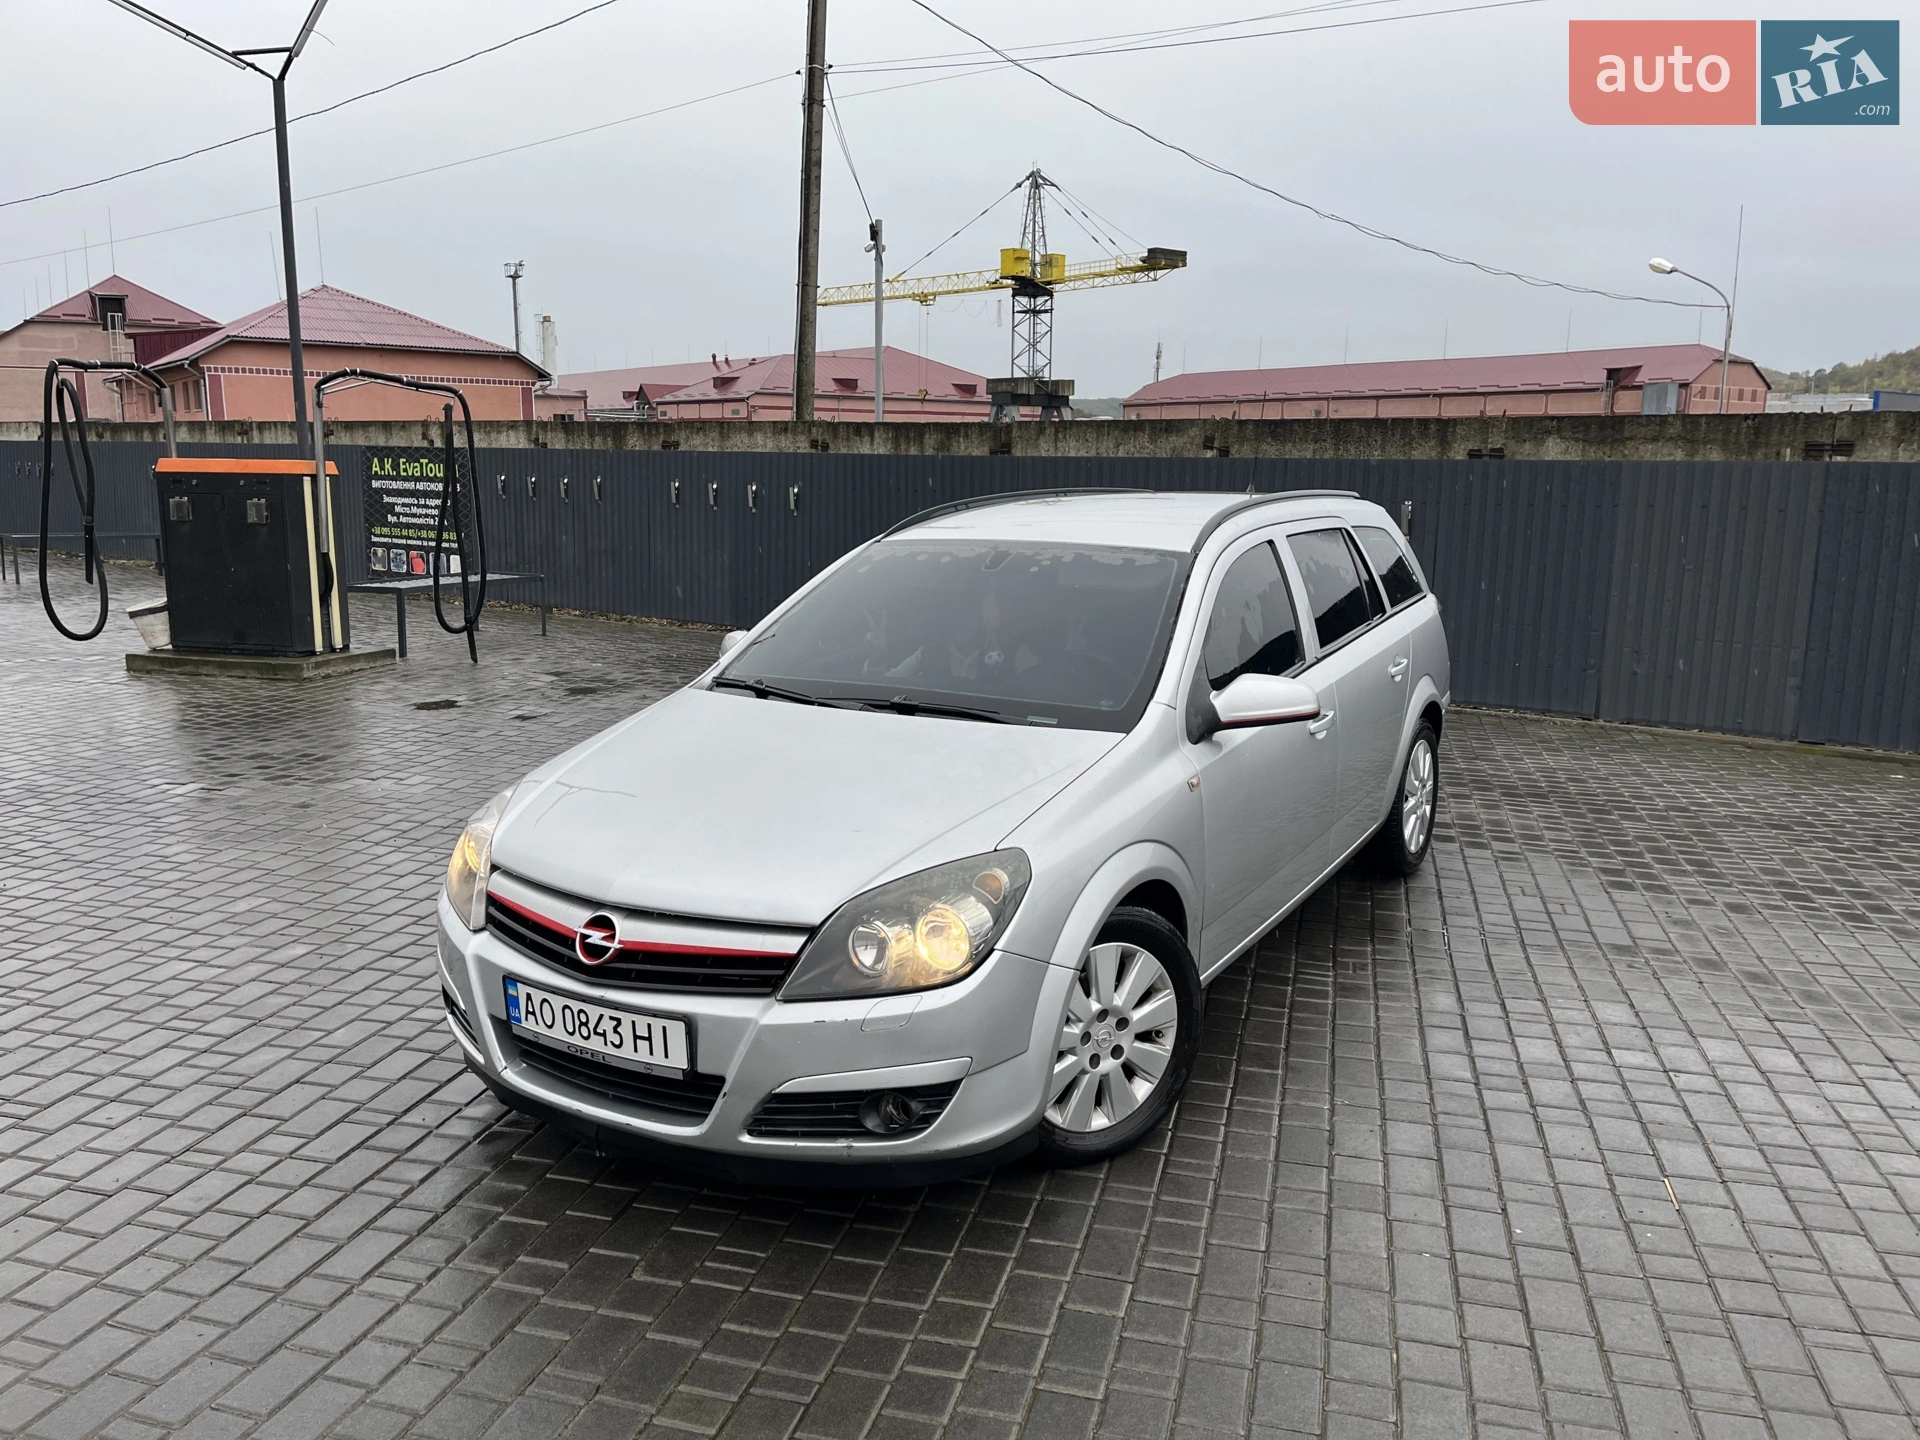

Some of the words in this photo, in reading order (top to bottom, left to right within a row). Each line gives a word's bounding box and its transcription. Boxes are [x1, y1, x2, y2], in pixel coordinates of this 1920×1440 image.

[372, 457, 396, 476] A.K.
[371, 480, 415, 490] ВИГОТОВЛЕННЯ
[382, 494, 418, 505] Знаходимось
[418, 497, 425, 505] за
[387, 513, 399, 524] Вул.
[371, 526, 381, 535] +38
[381, 527, 391, 536] 095
[391, 527, 401, 536] 555
[401, 528, 409, 537] 44
[509, 1006, 521, 1018] UA
[524, 992, 556, 1030] AO
[561, 1004, 624, 1050] 0843
[630, 1019, 670, 1060] HI
[566, 1044, 613, 1065] OPEL
